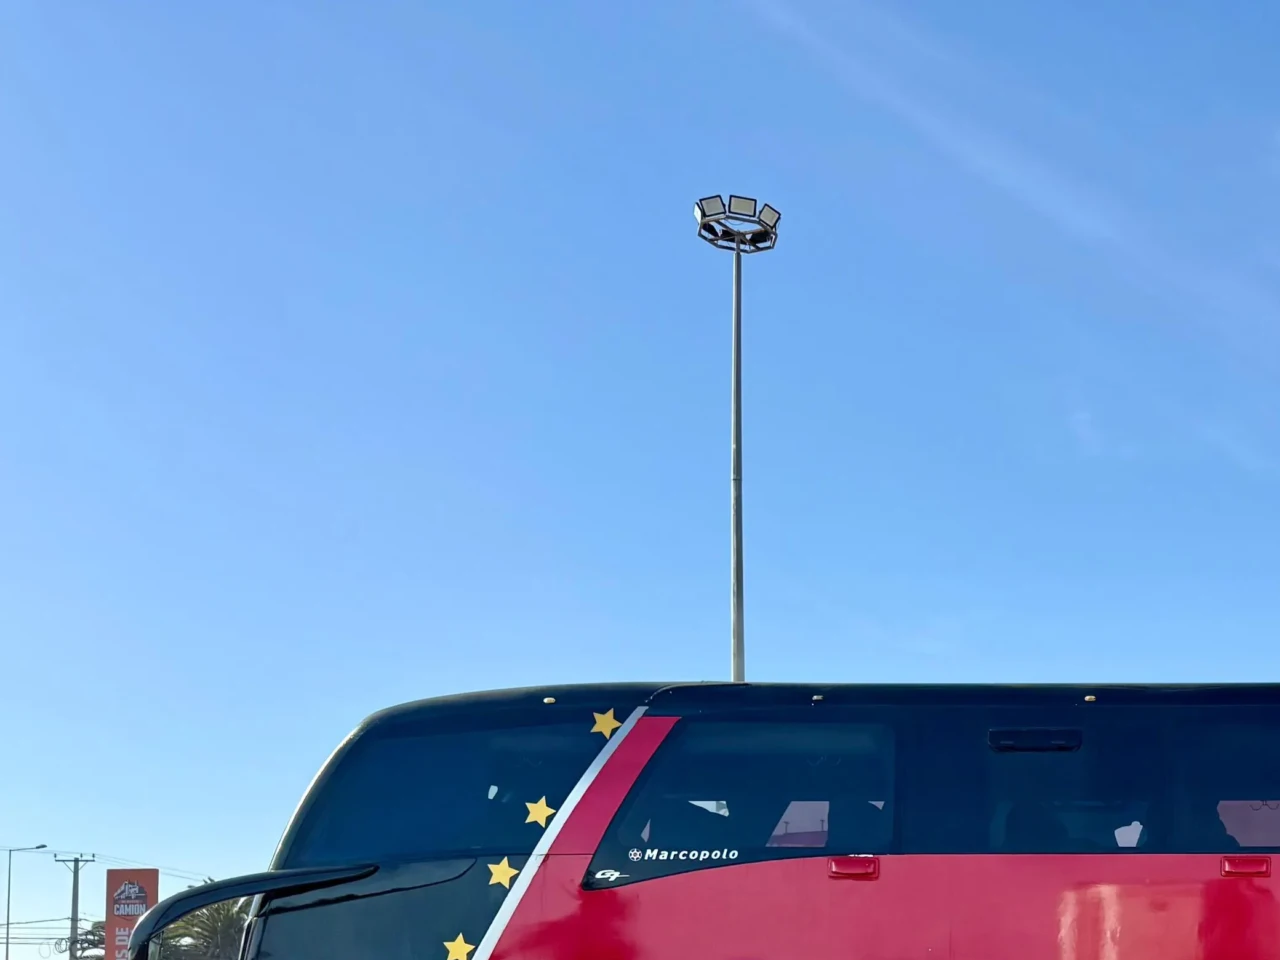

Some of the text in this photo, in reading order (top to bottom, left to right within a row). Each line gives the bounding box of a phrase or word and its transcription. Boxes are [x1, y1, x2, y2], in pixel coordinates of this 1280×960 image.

[644, 848, 739, 861] Marcopolo
[113, 903, 146, 915] CAMION
[115, 927, 129, 945] DE
